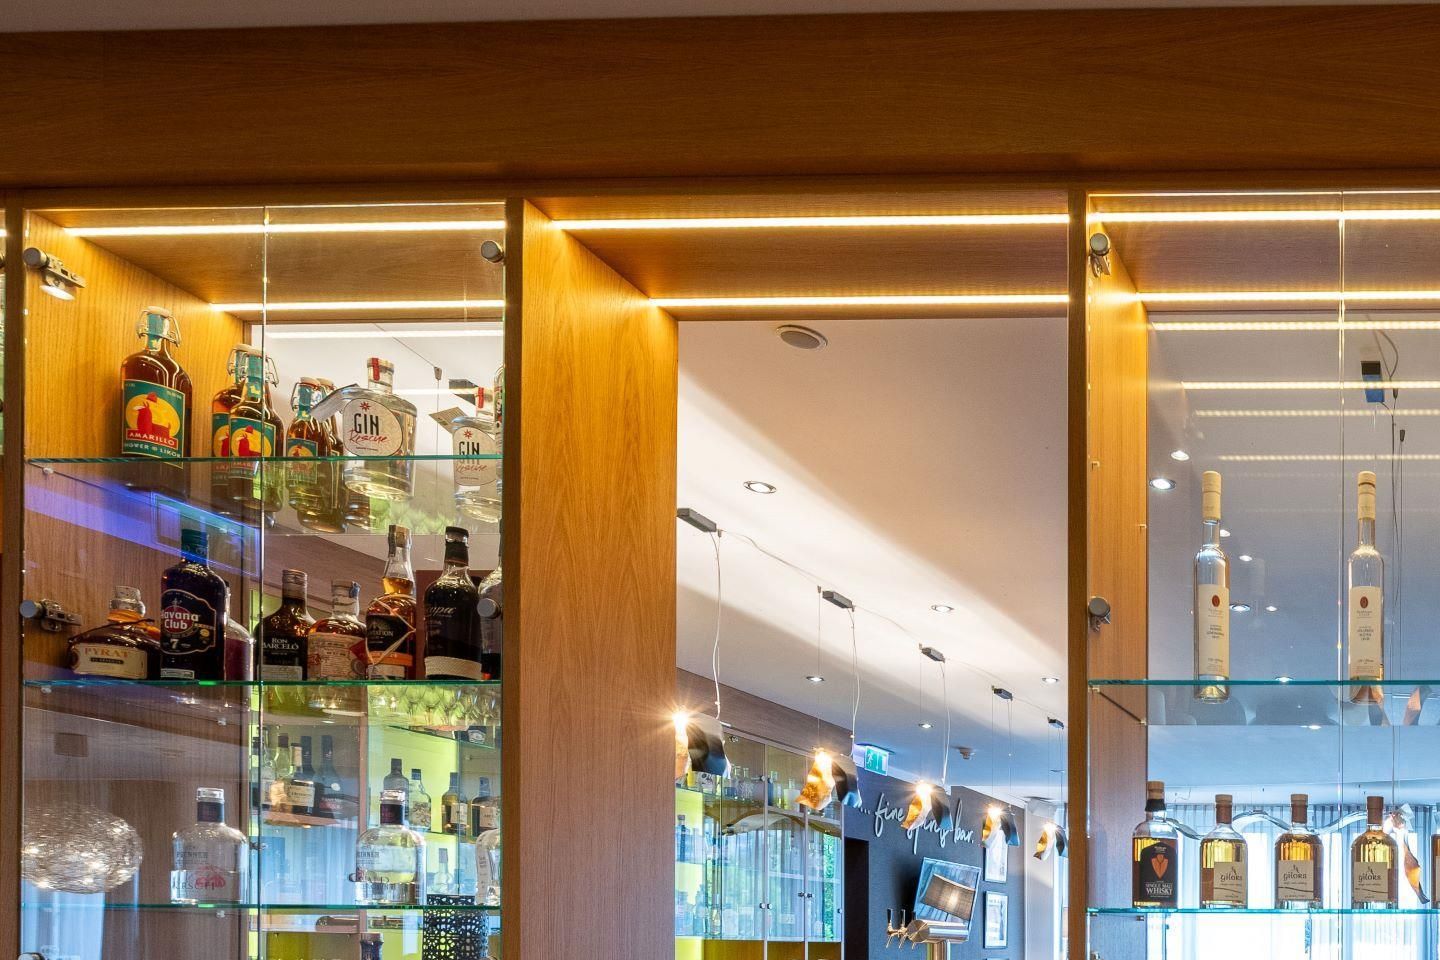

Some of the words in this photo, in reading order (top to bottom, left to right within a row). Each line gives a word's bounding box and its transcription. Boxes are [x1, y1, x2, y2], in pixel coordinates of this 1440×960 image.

[354, 413, 379, 436] GIN
[129, 431, 175, 446] AMARILLO
[349, 430, 390, 445] Rescue
[459, 441, 480, 465] GIN
[164, 618, 188, 630] Club
[170, 638, 179, 650] 7
[84, 647, 128, 658] PYRAT
[875, 793, 905, 838] fine
[1146, 887, 1173, 895] WHISKY
